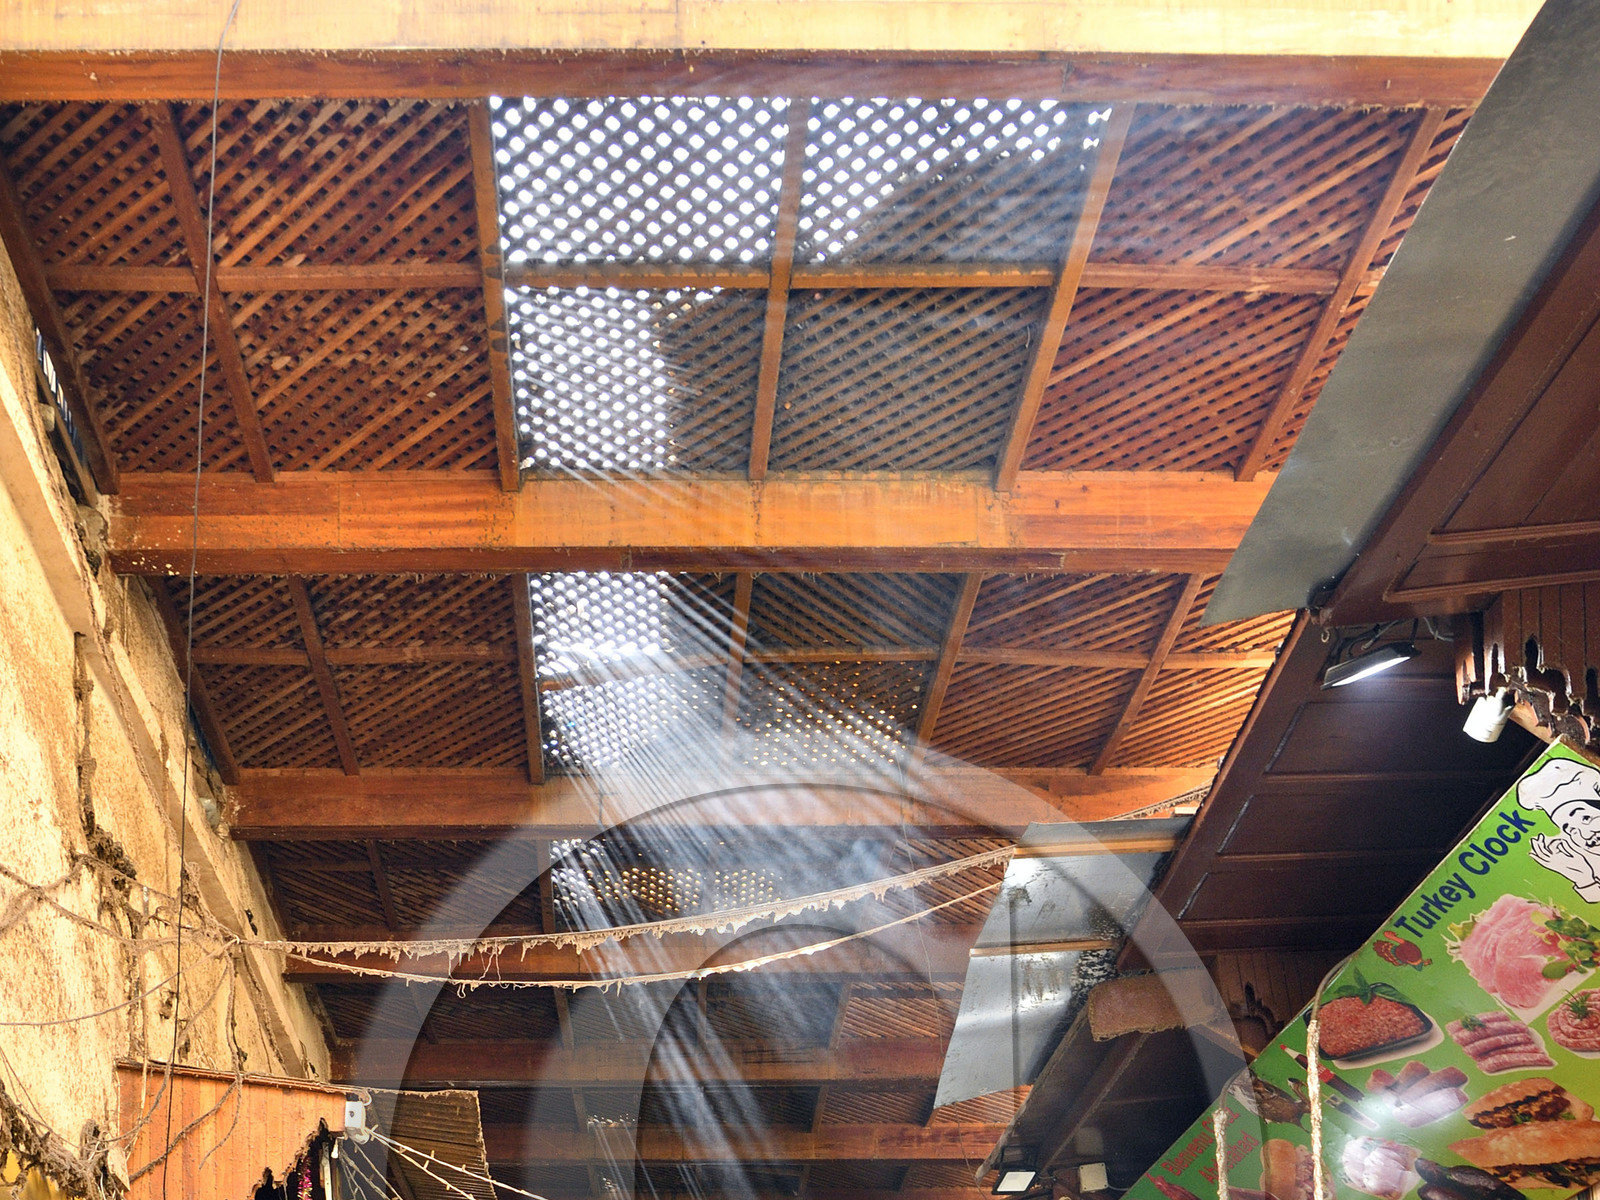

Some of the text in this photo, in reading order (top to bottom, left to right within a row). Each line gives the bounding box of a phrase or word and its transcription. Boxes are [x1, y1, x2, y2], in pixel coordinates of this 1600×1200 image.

[1393, 809, 1536, 939] Turkey Clock
[1202, 1106, 1239, 1134] Cz
